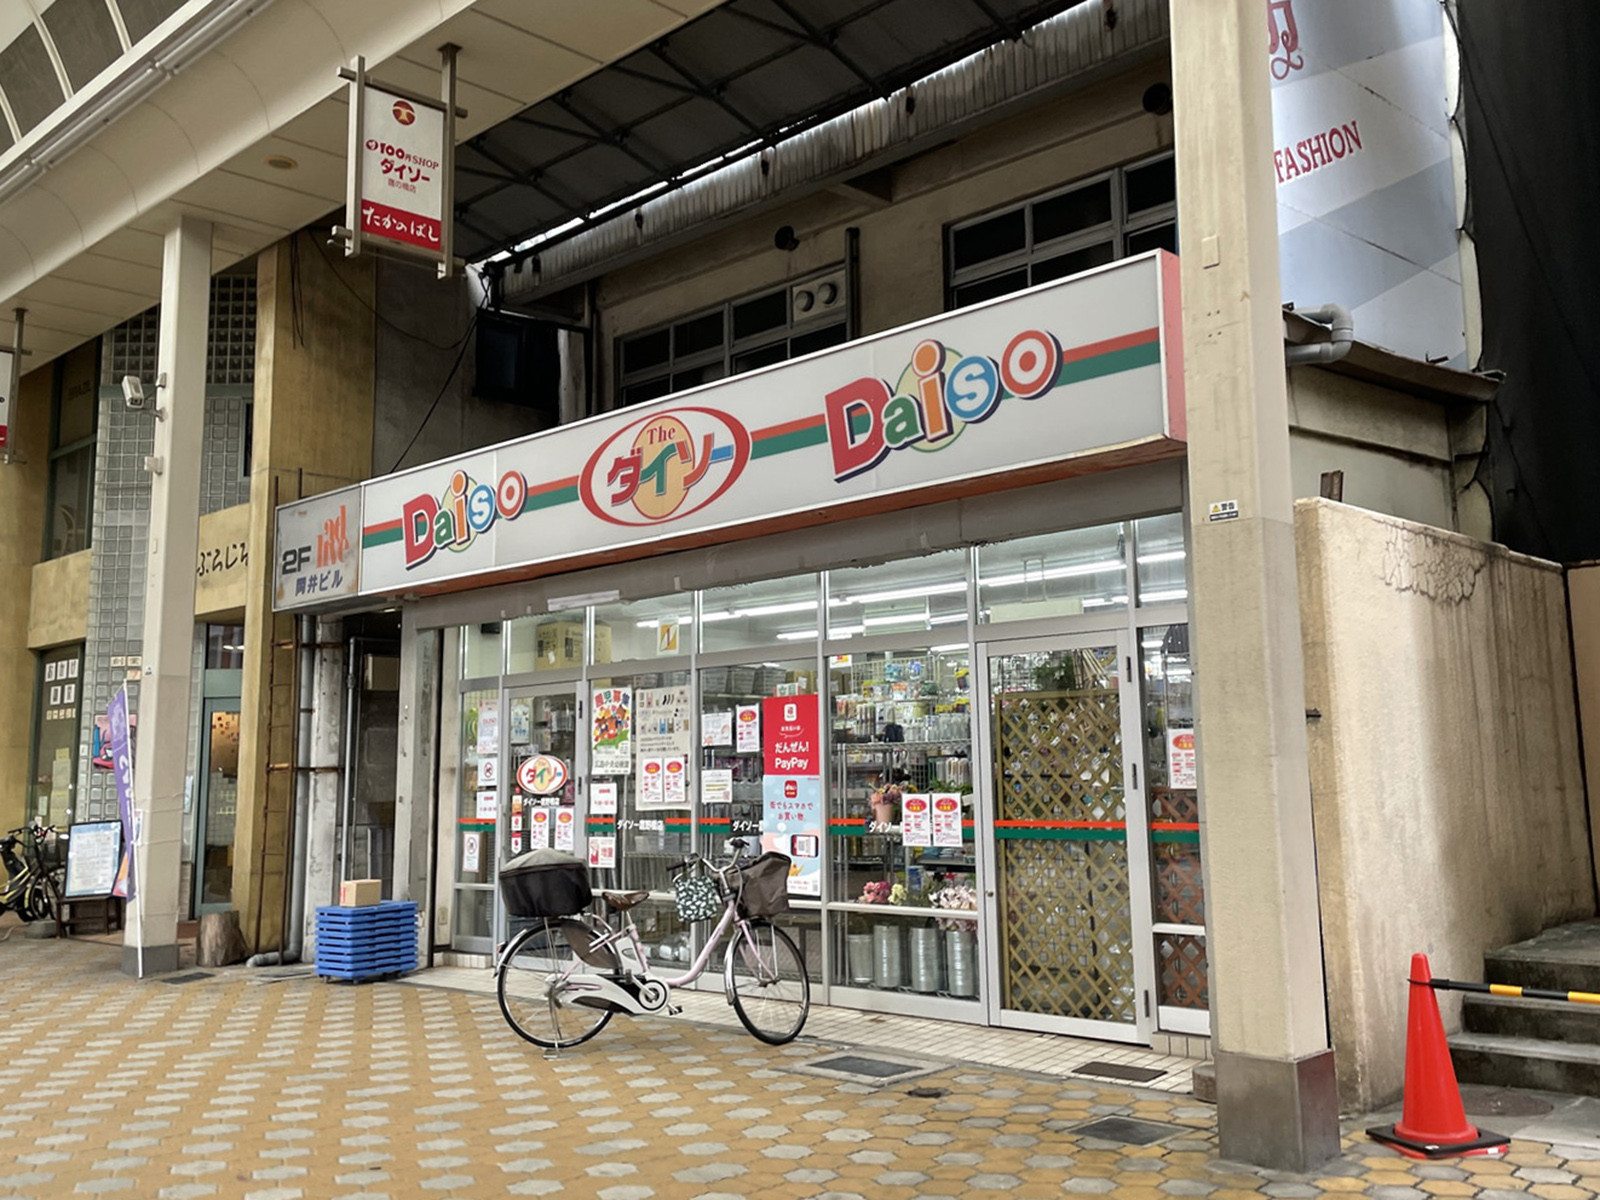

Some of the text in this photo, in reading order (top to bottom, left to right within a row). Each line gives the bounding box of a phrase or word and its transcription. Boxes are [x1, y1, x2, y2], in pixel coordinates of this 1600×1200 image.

[380, 157, 430, 183] ダイソー
[1273, 121, 1362, 183] FASHION
[363, 206, 439, 242] たかのばし
[825, 330, 1063, 484] Daiso
[646, 426, 677, 445] The
[607, 432, 734, 507] ダイソー
[402, 469, 528, 571] Daiso
[282, 545, 311, 575] 2F
[775, 756, 809, 770] PayPay
